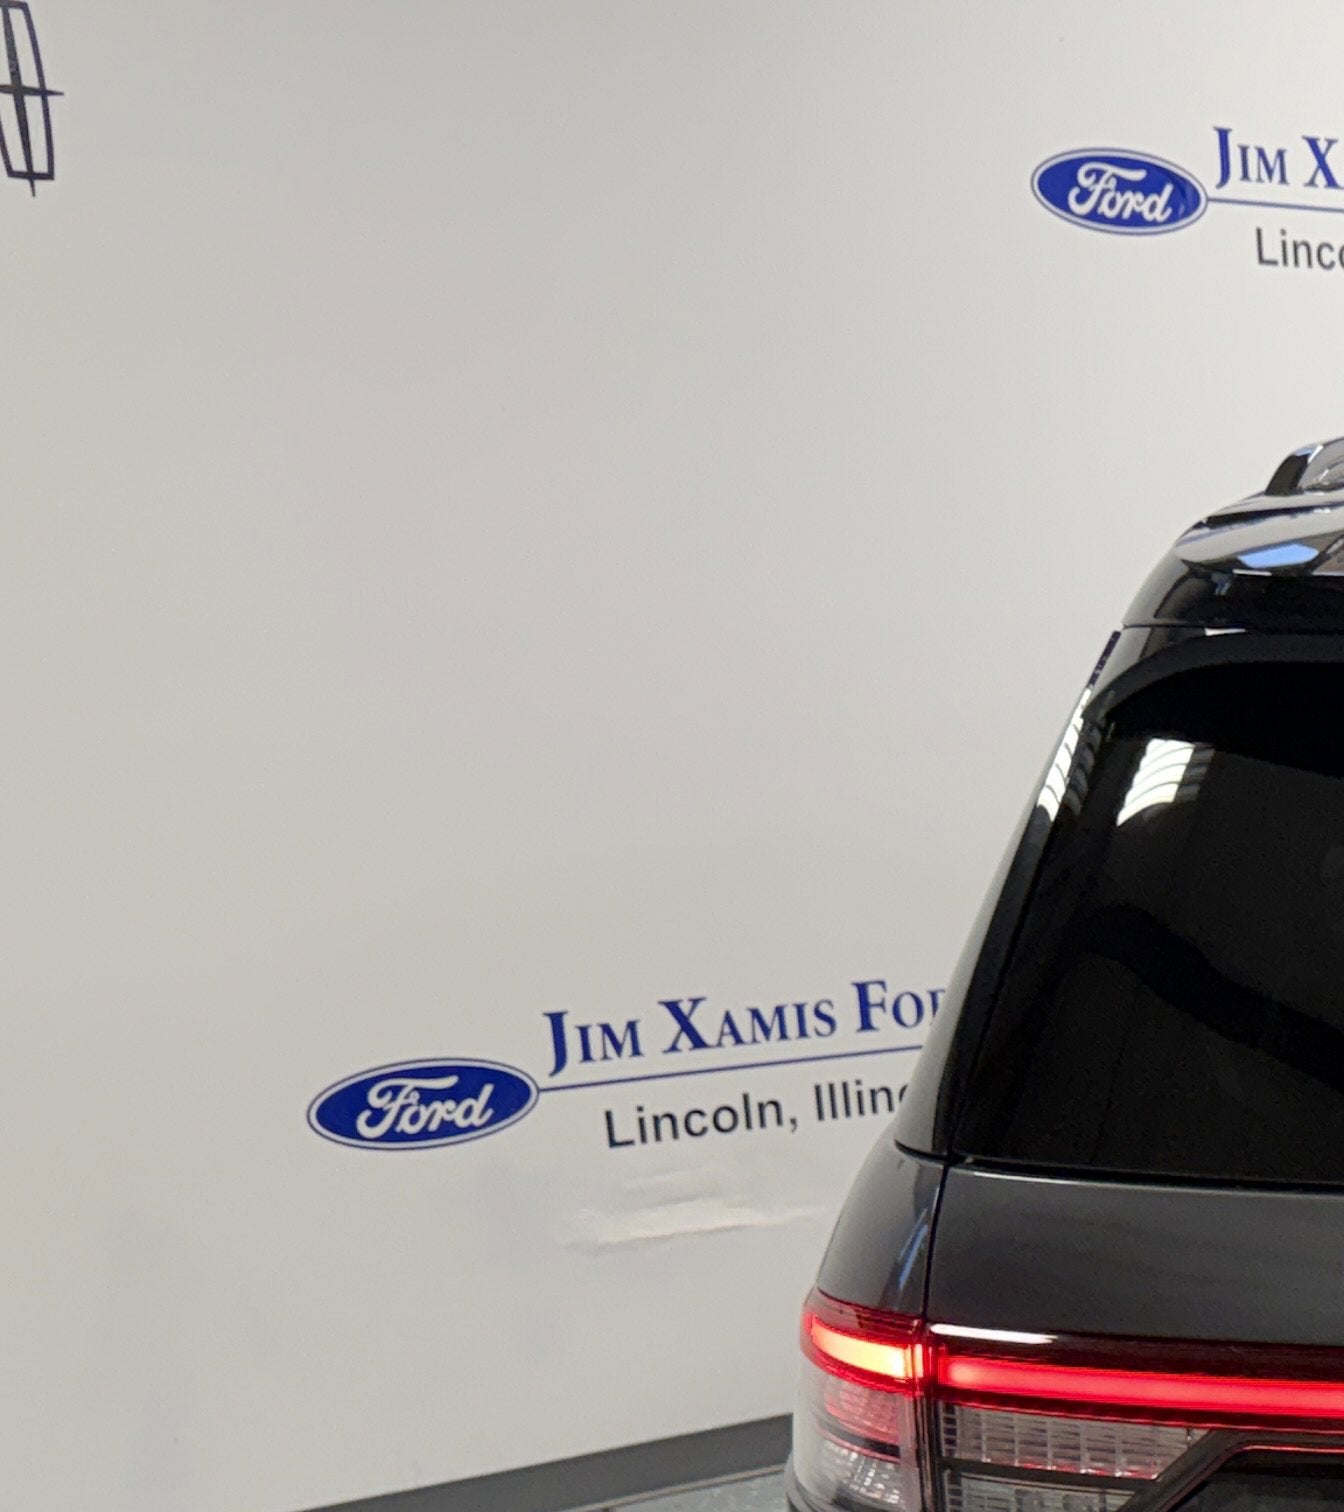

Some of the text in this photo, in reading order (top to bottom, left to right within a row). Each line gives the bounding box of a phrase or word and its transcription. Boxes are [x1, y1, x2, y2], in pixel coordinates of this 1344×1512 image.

[1212, 126, 1290, 188] JIM
[1068, 161, 1174, 222] Ford
[543, 980, 945, 1077] JIM XAMIS FO
[355, 1074, 496, 1139] Ford
[605, 1078, 908, 1148] Lincoln, Illin
